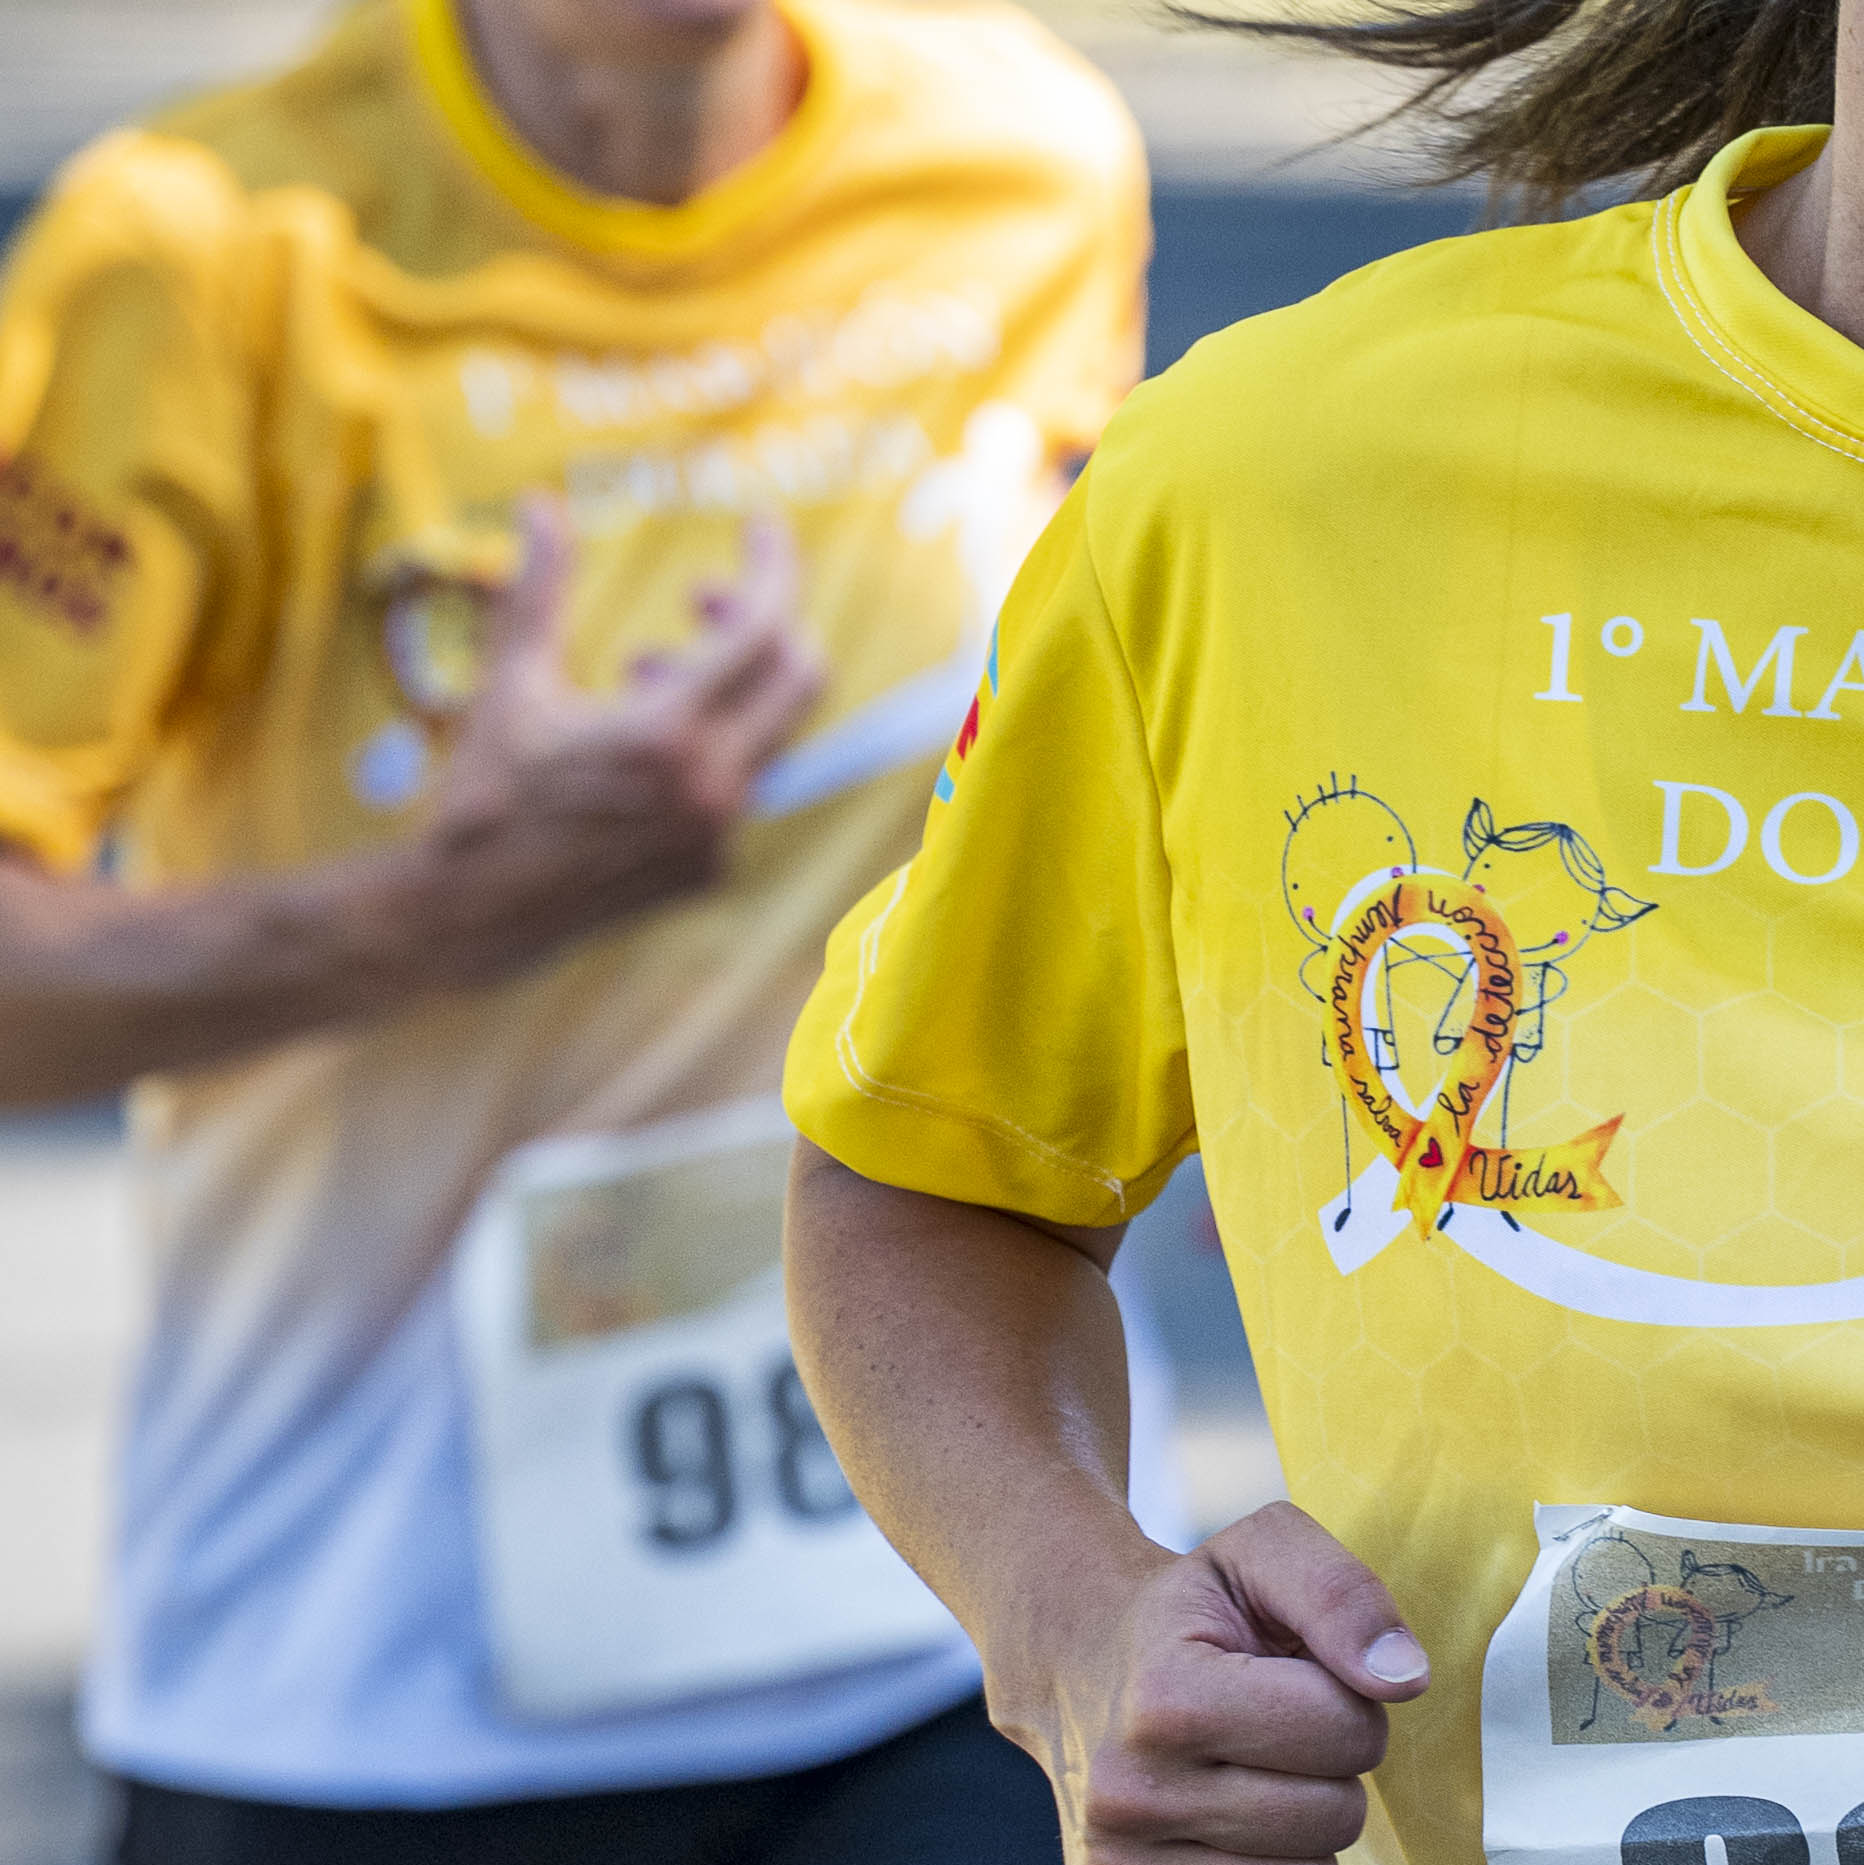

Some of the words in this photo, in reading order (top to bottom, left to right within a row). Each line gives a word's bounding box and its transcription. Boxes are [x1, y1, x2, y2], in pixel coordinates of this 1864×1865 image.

[1349, 1074, 1402, 1149] salva
[1438, 1080, 1480, 1137] la
[1468, 1149, 1584, 1203] Vidas
